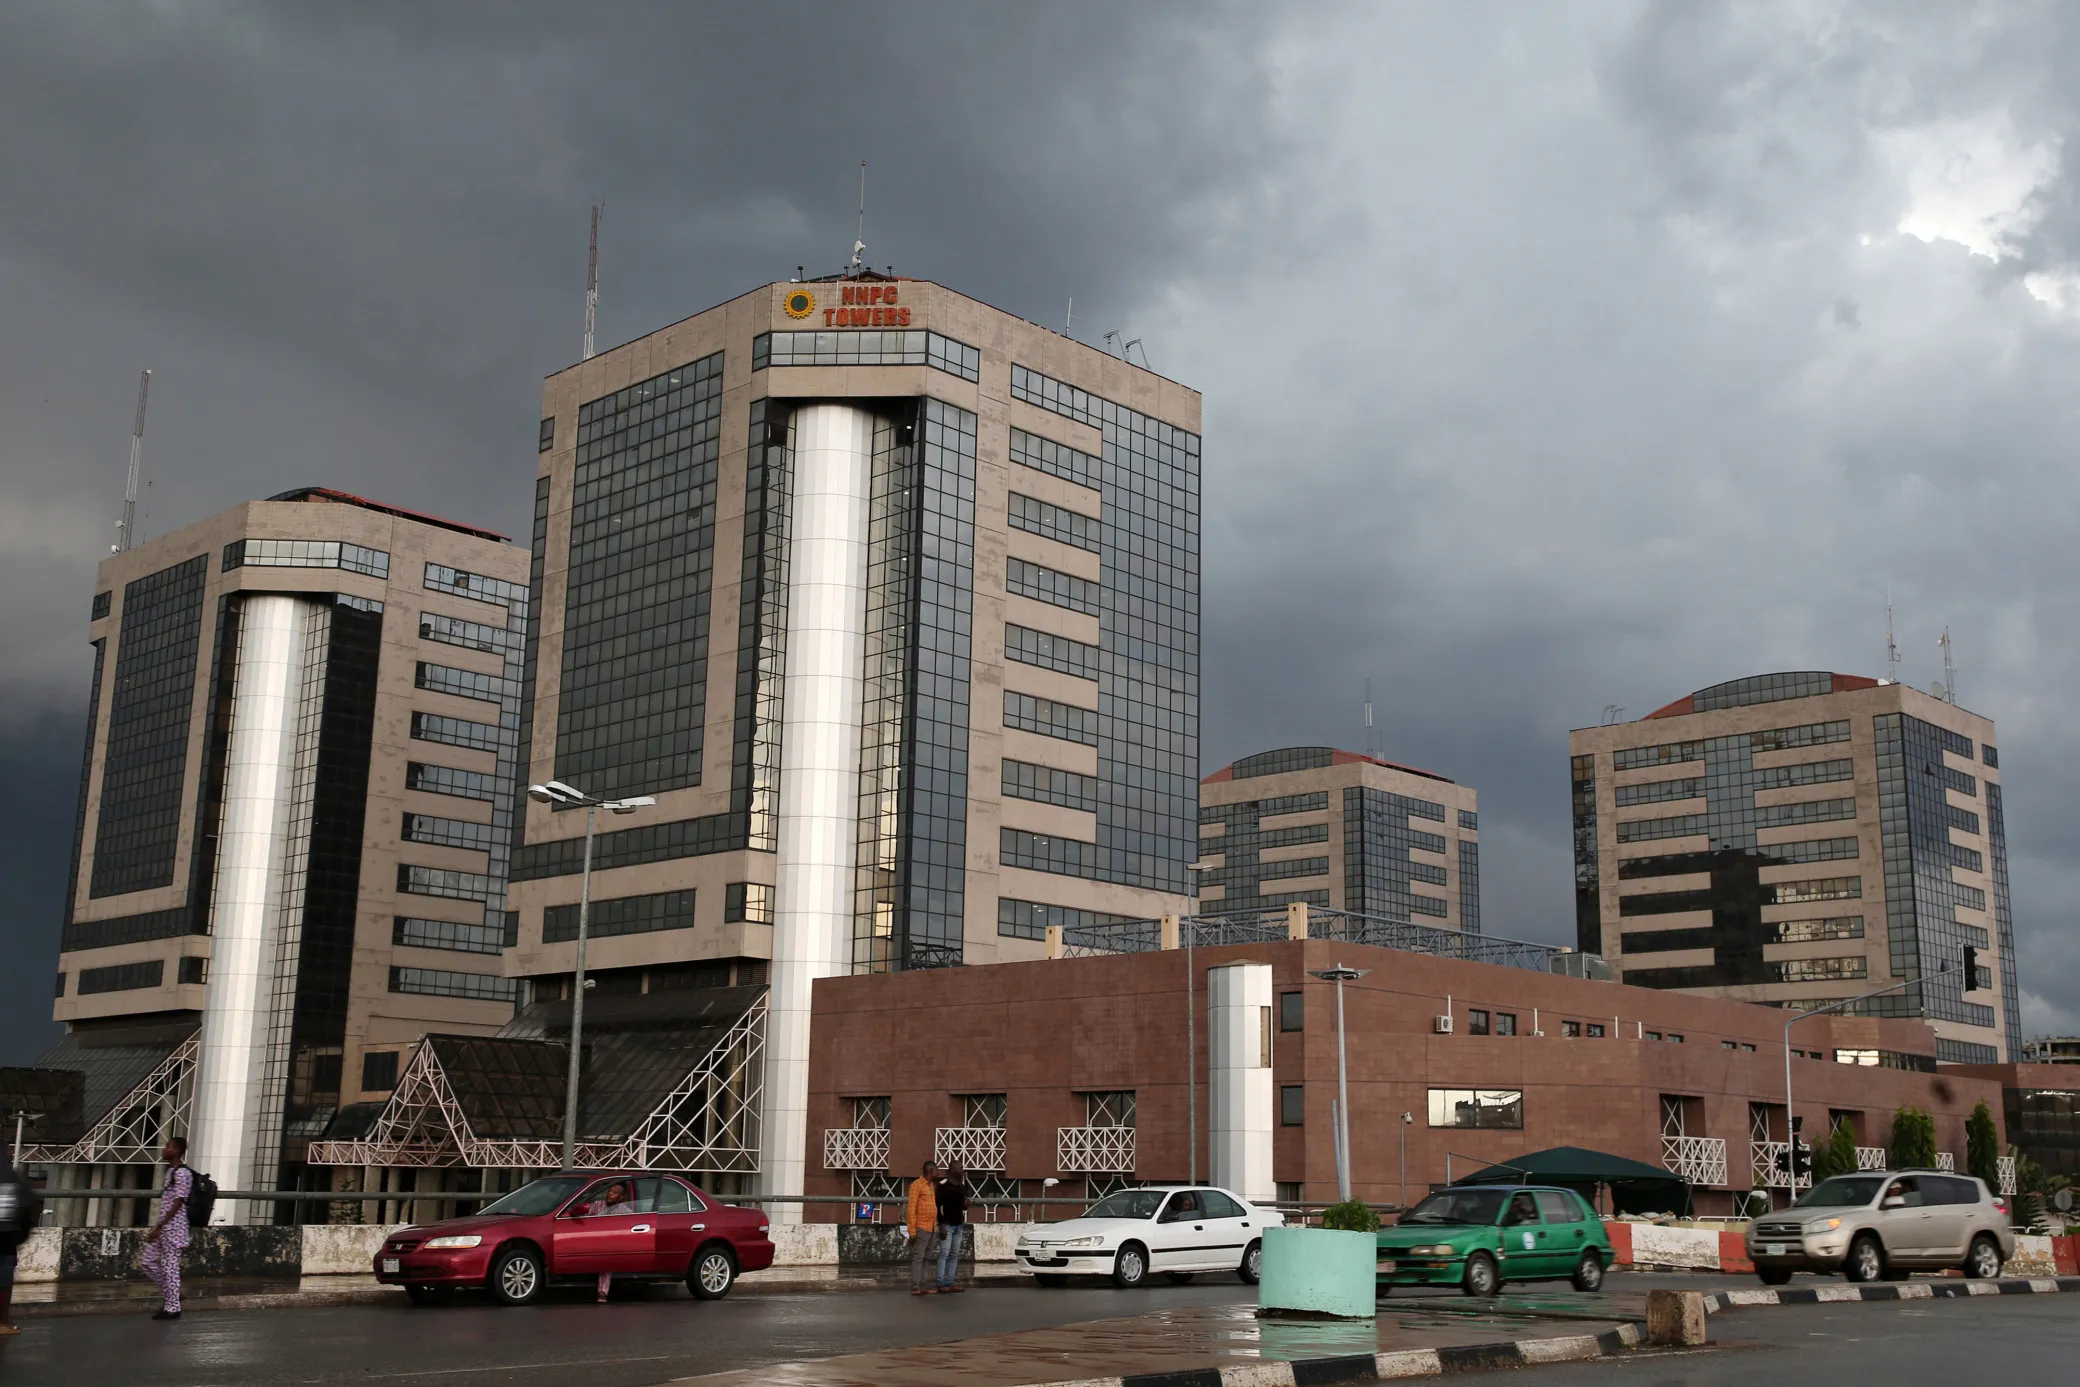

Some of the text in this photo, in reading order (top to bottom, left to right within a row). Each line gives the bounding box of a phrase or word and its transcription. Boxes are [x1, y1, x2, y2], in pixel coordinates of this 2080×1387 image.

[842, 286, 898, 305] NNPC
[823, 307, 911, 327] TOWERS
[861, 1204, 871, 1215] P
